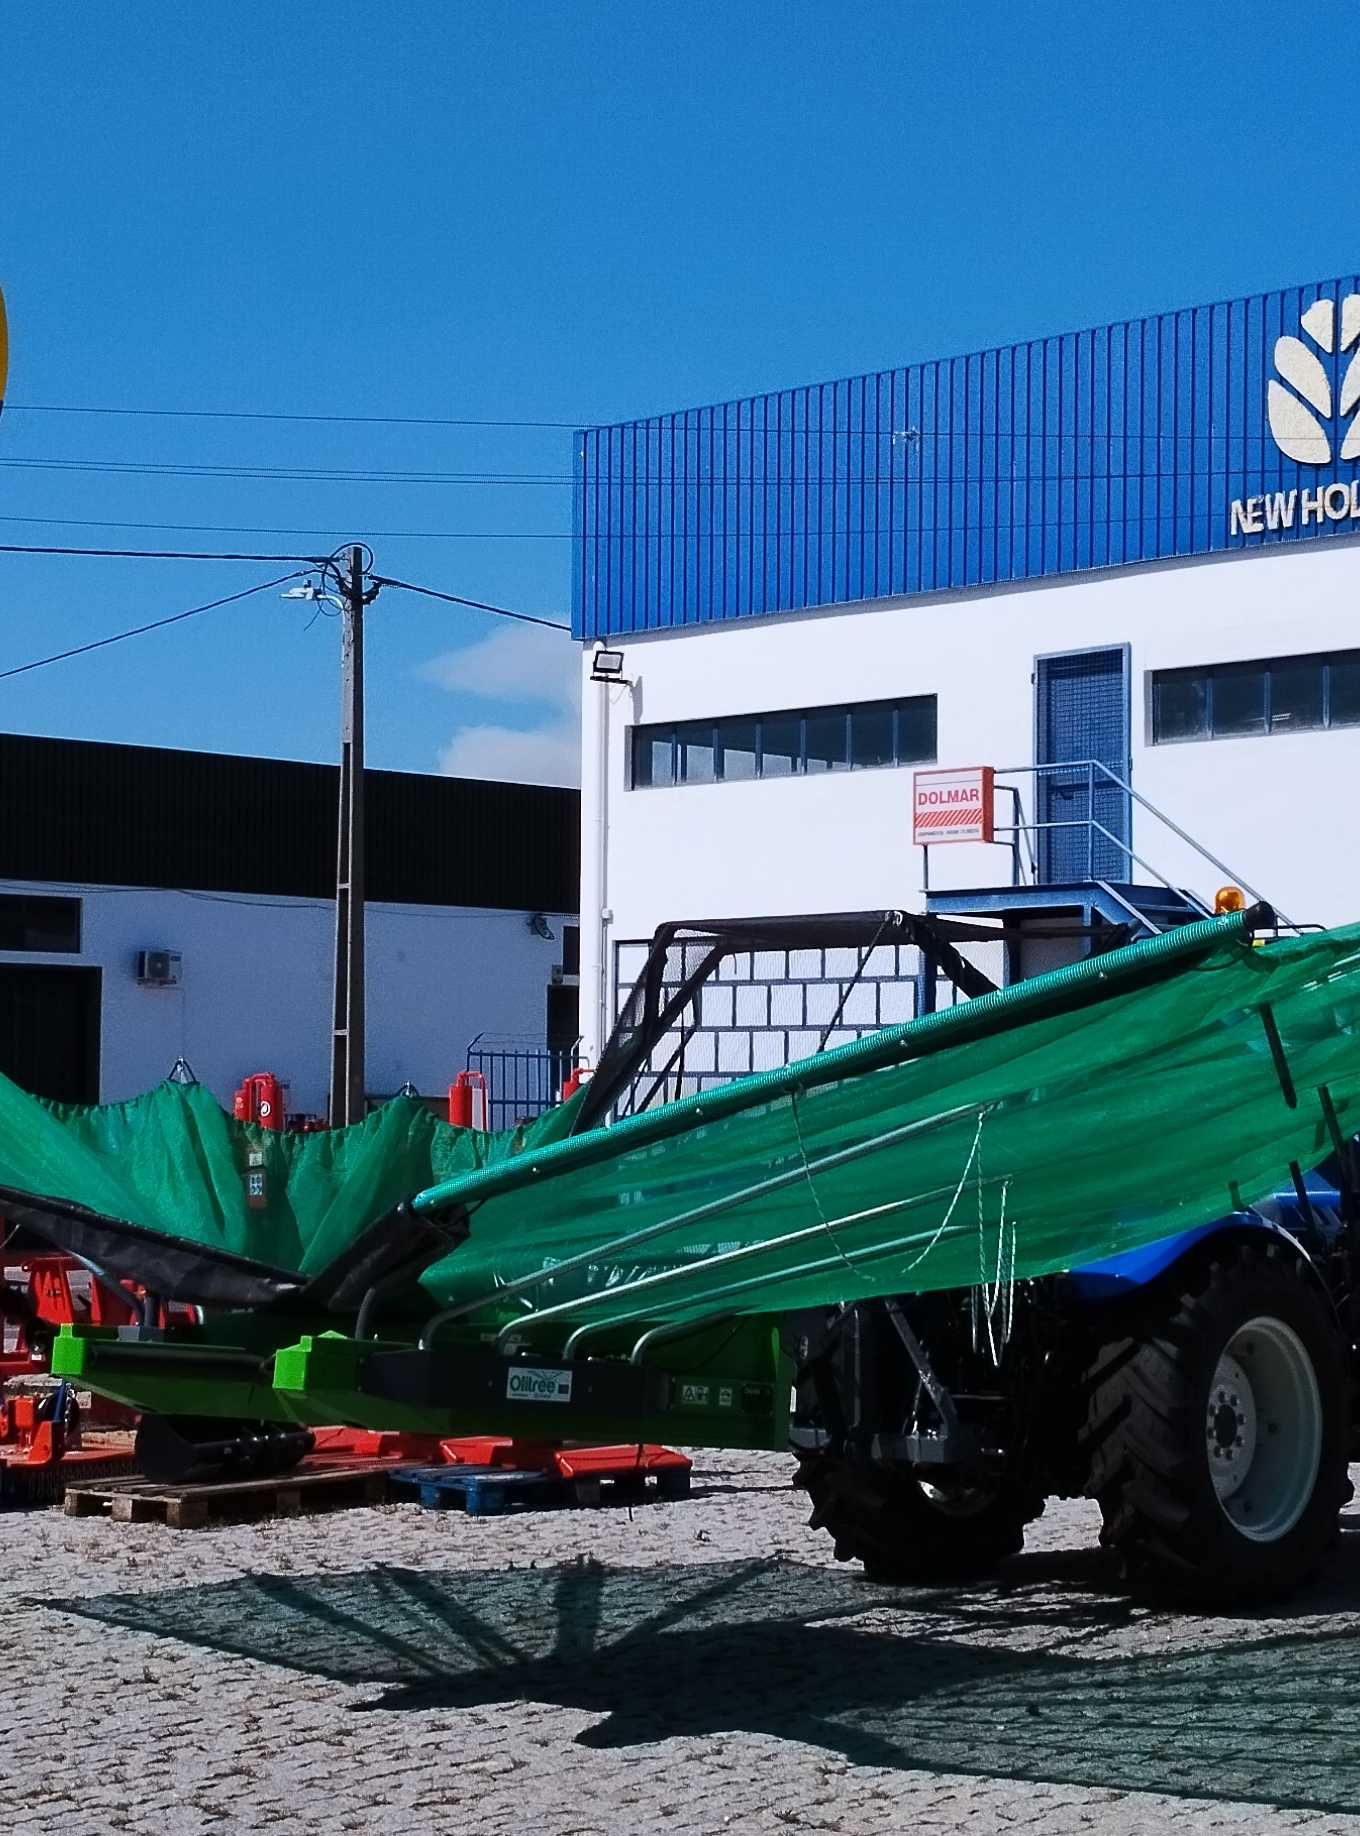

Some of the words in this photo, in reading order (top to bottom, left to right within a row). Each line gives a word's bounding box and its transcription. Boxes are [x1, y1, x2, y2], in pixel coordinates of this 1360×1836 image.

[1230, 488, 1297, 535] NEW
[918, 787, 980, 806] DOLMAR
[510, 1375, 556, 1393] Olitree
